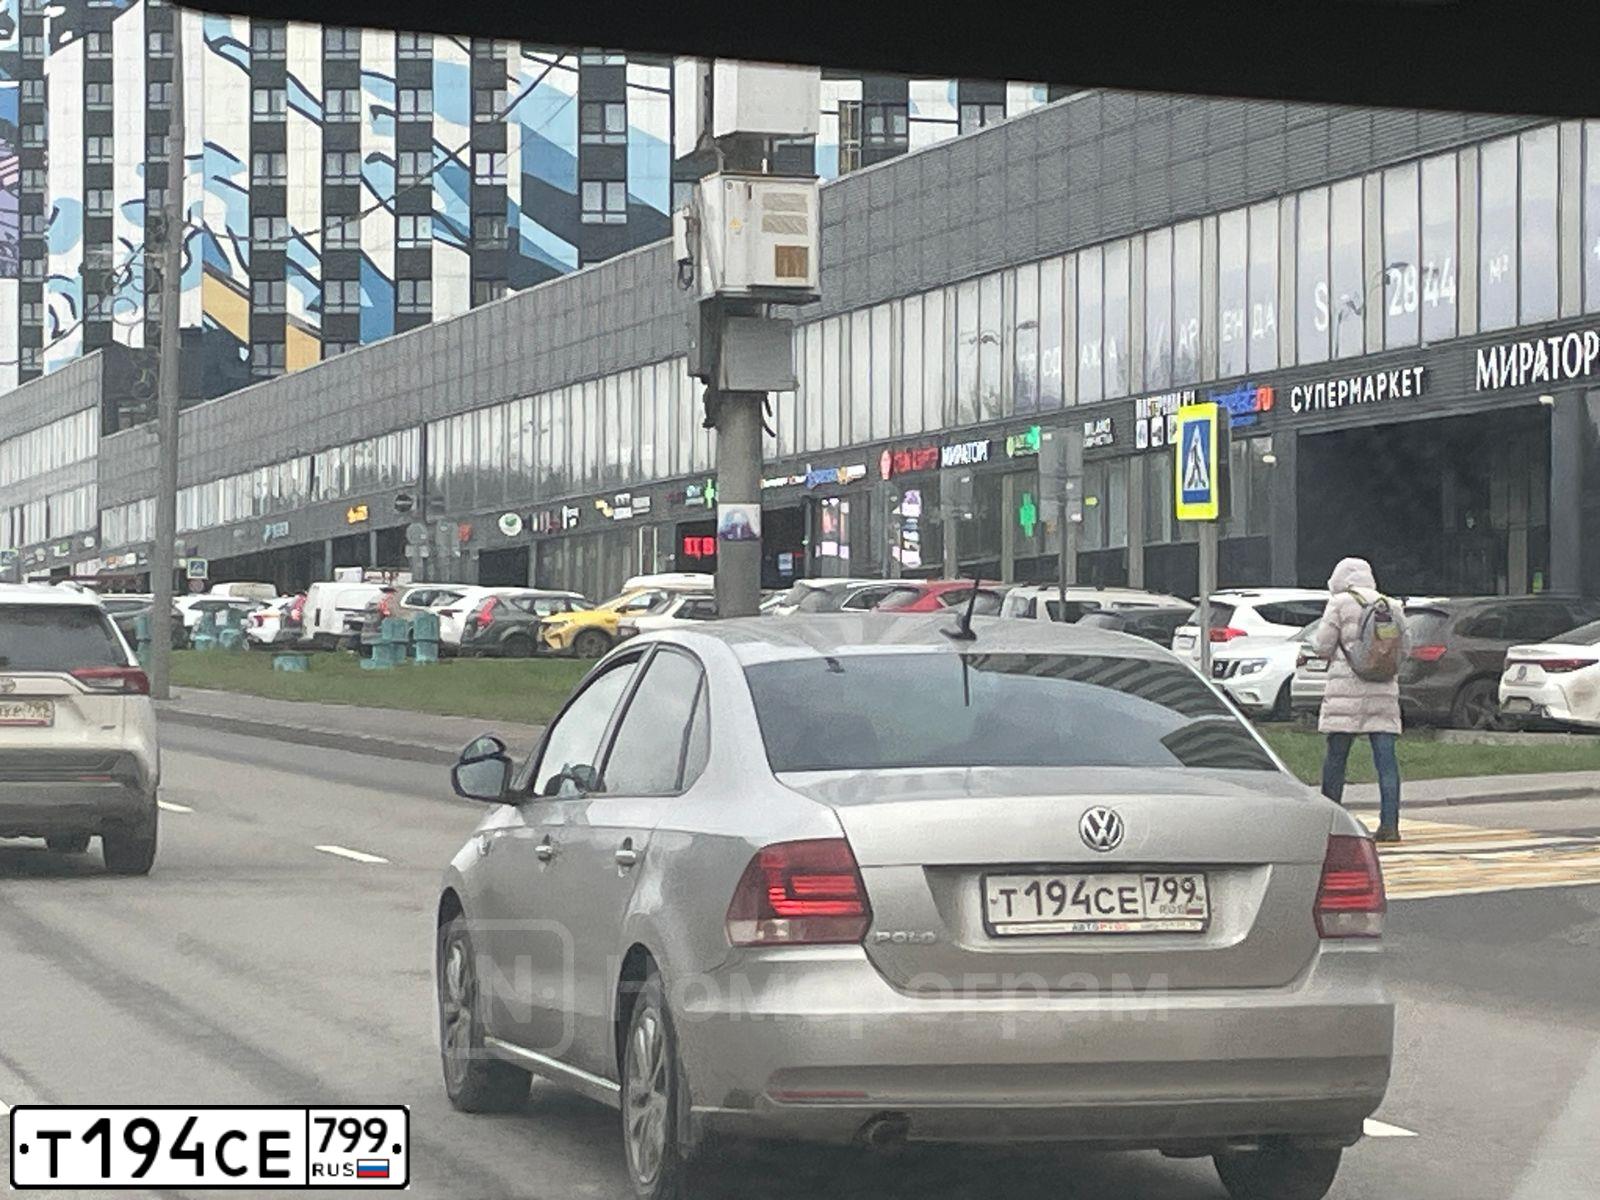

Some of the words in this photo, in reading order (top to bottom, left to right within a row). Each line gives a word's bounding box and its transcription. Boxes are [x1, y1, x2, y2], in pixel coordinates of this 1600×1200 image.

[1475, 329, 1600, 393] МИРАТОР
[1290, 365, 1426, 414] СУПЕРМАРКЕТ
[1144, 875, 1198, 905] 799
[874, 930, 937, 945] POLO
